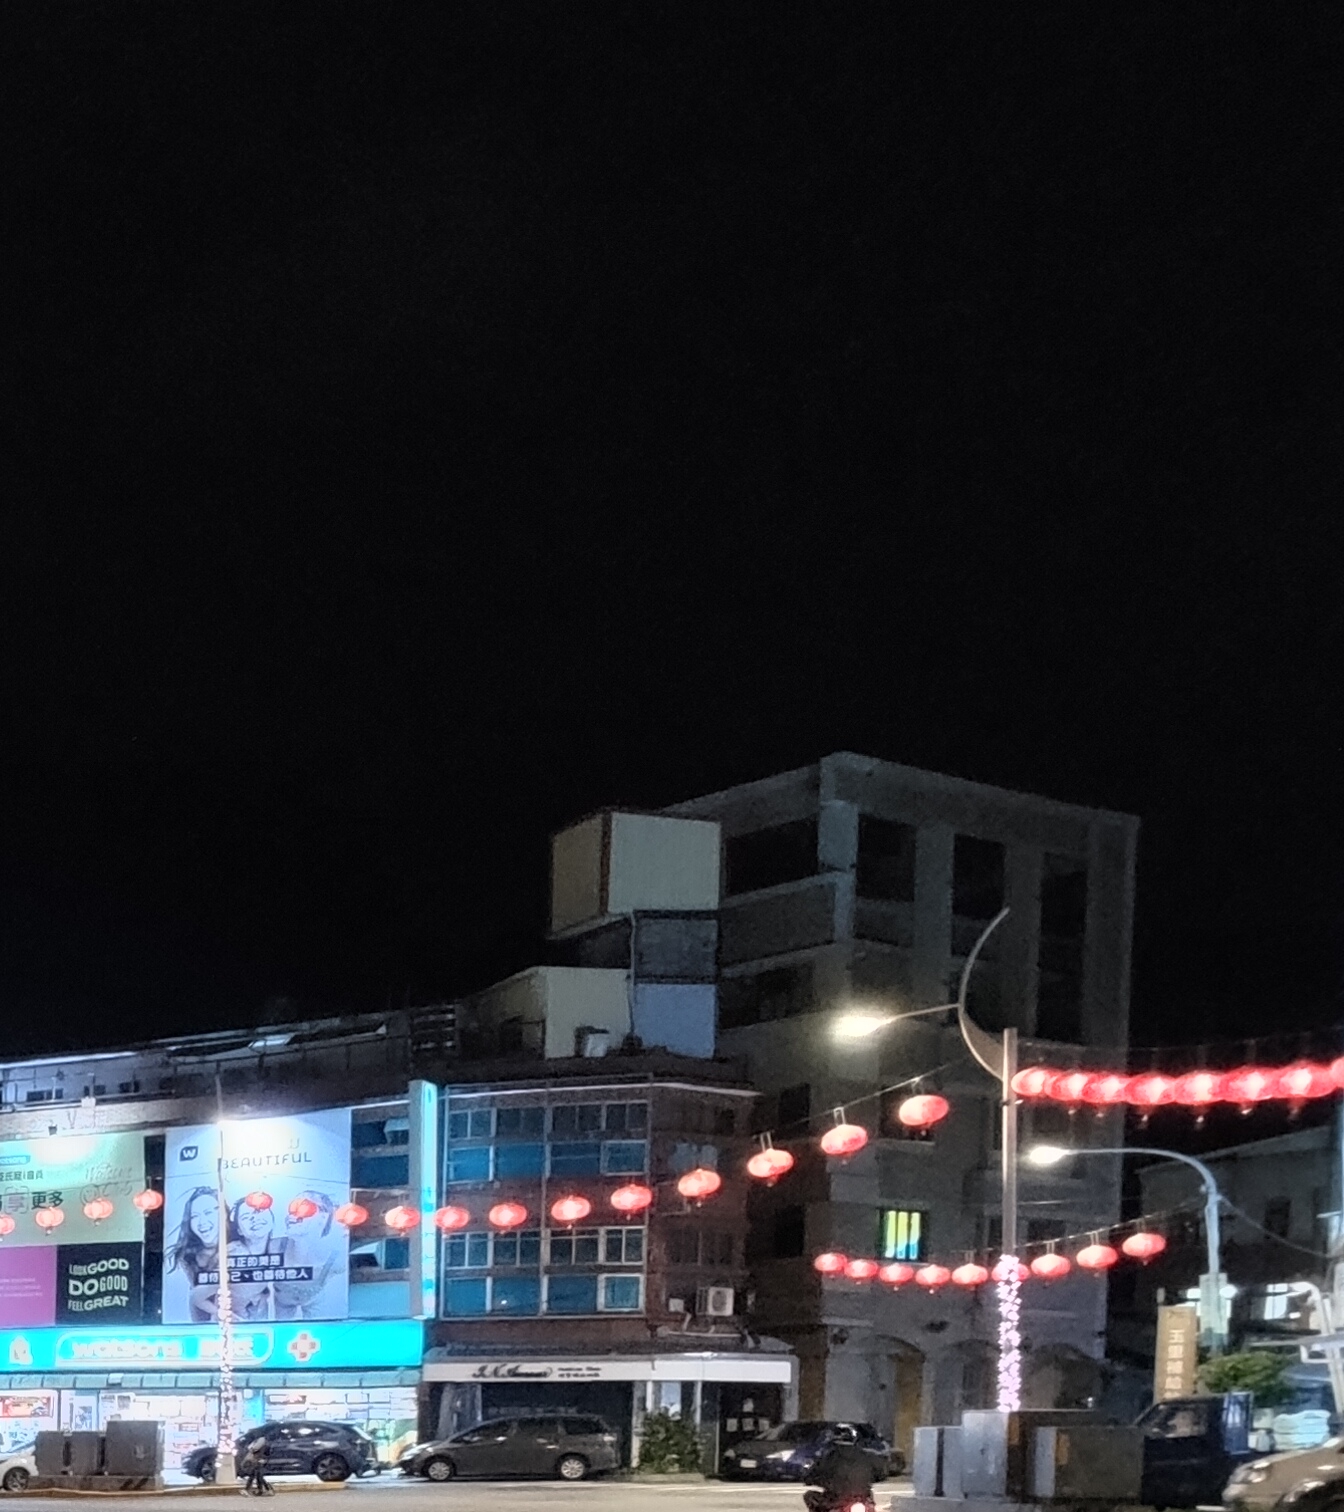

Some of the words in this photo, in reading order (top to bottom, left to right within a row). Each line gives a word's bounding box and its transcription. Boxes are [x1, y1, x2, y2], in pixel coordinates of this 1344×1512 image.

[223, 1152, 312, 1169] BEAUTIFUL
[87, 1258, 129, 1275] GOOD
[68, 1279, 99, 1295] DO
[99, 1275, 128, 1292] GOOD
[68, 1300, 84, 1311] FEEL
[84, 1296, 129, 1311] GREAT
